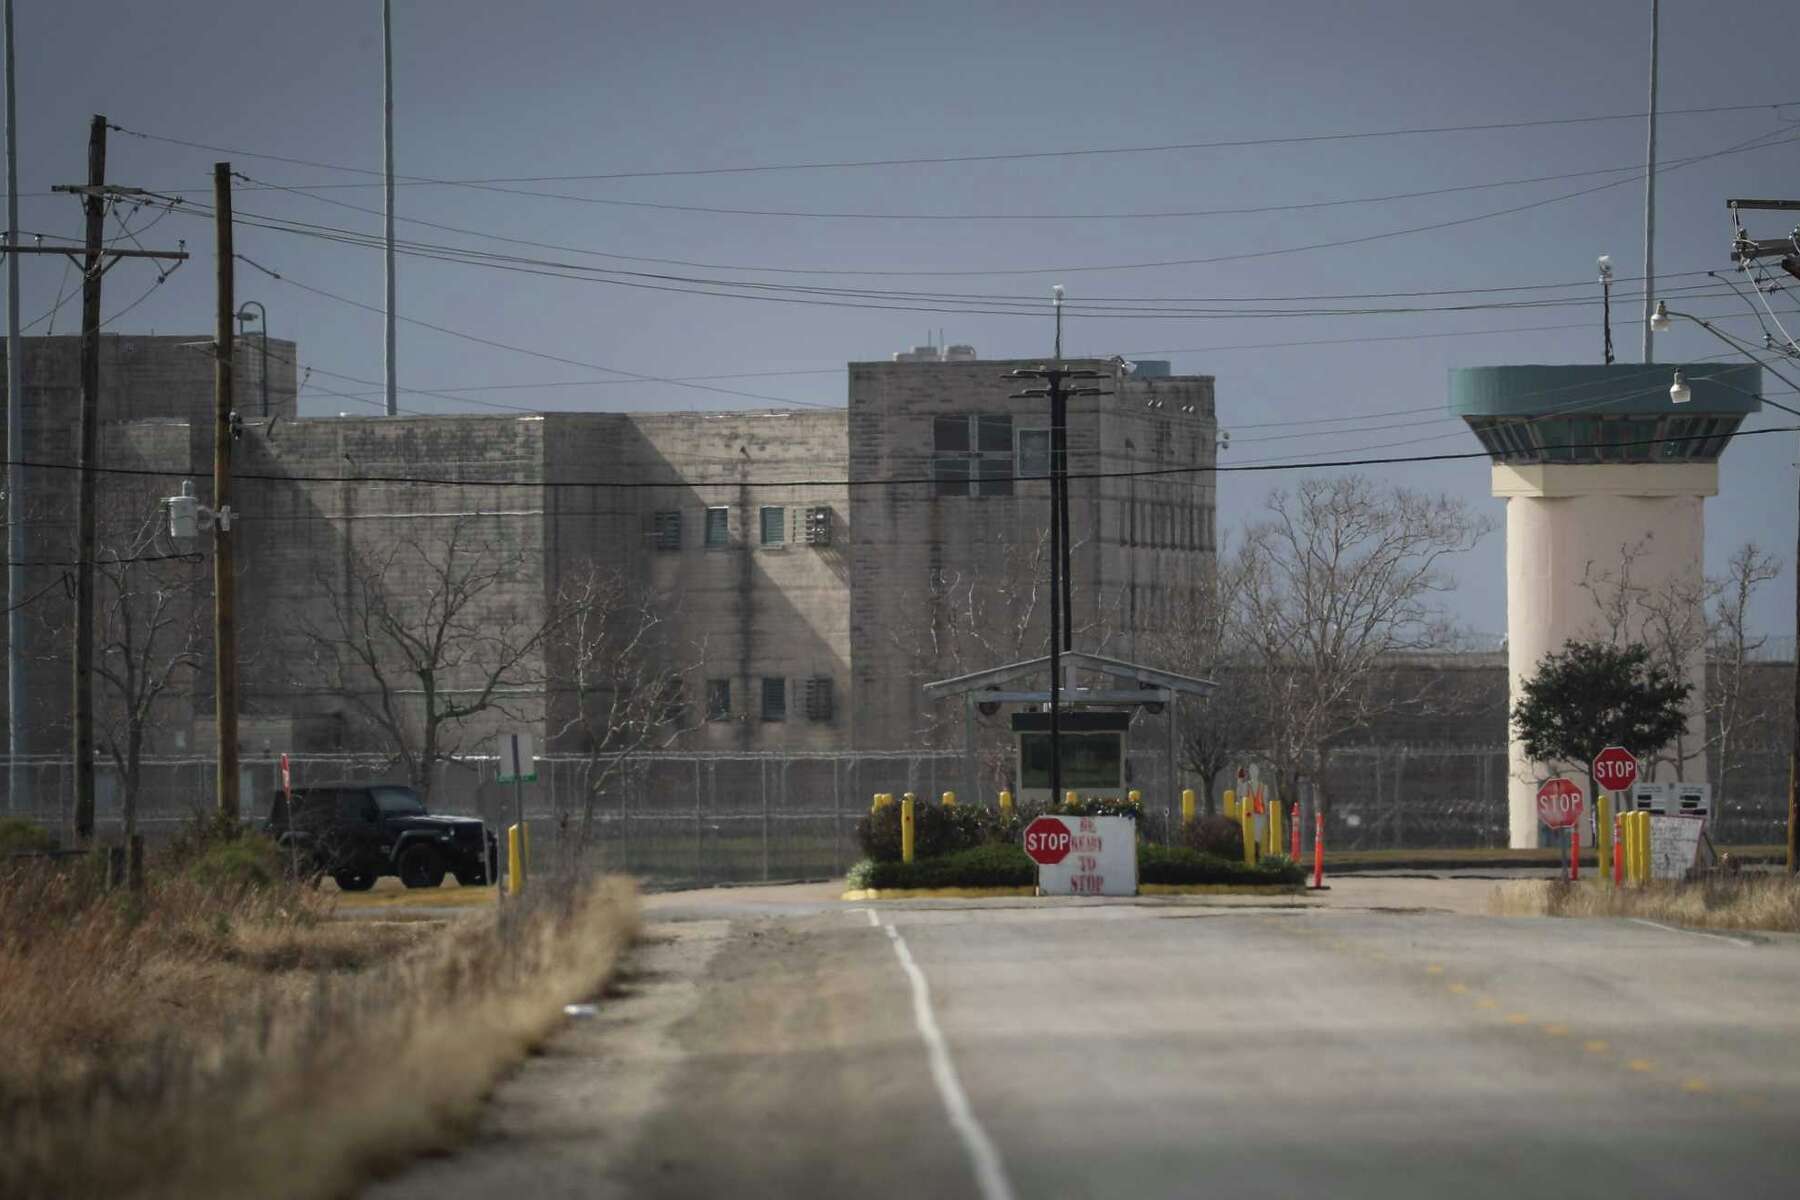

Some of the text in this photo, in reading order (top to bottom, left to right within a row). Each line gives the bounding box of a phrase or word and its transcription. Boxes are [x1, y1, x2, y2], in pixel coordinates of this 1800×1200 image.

[1597, 761, 1634, 778] STOP
[1540, 793, 1580, 815] STOP
[1027, 833, 1069, 851] STOP
[1071, 875, 1104, 894] STOP
